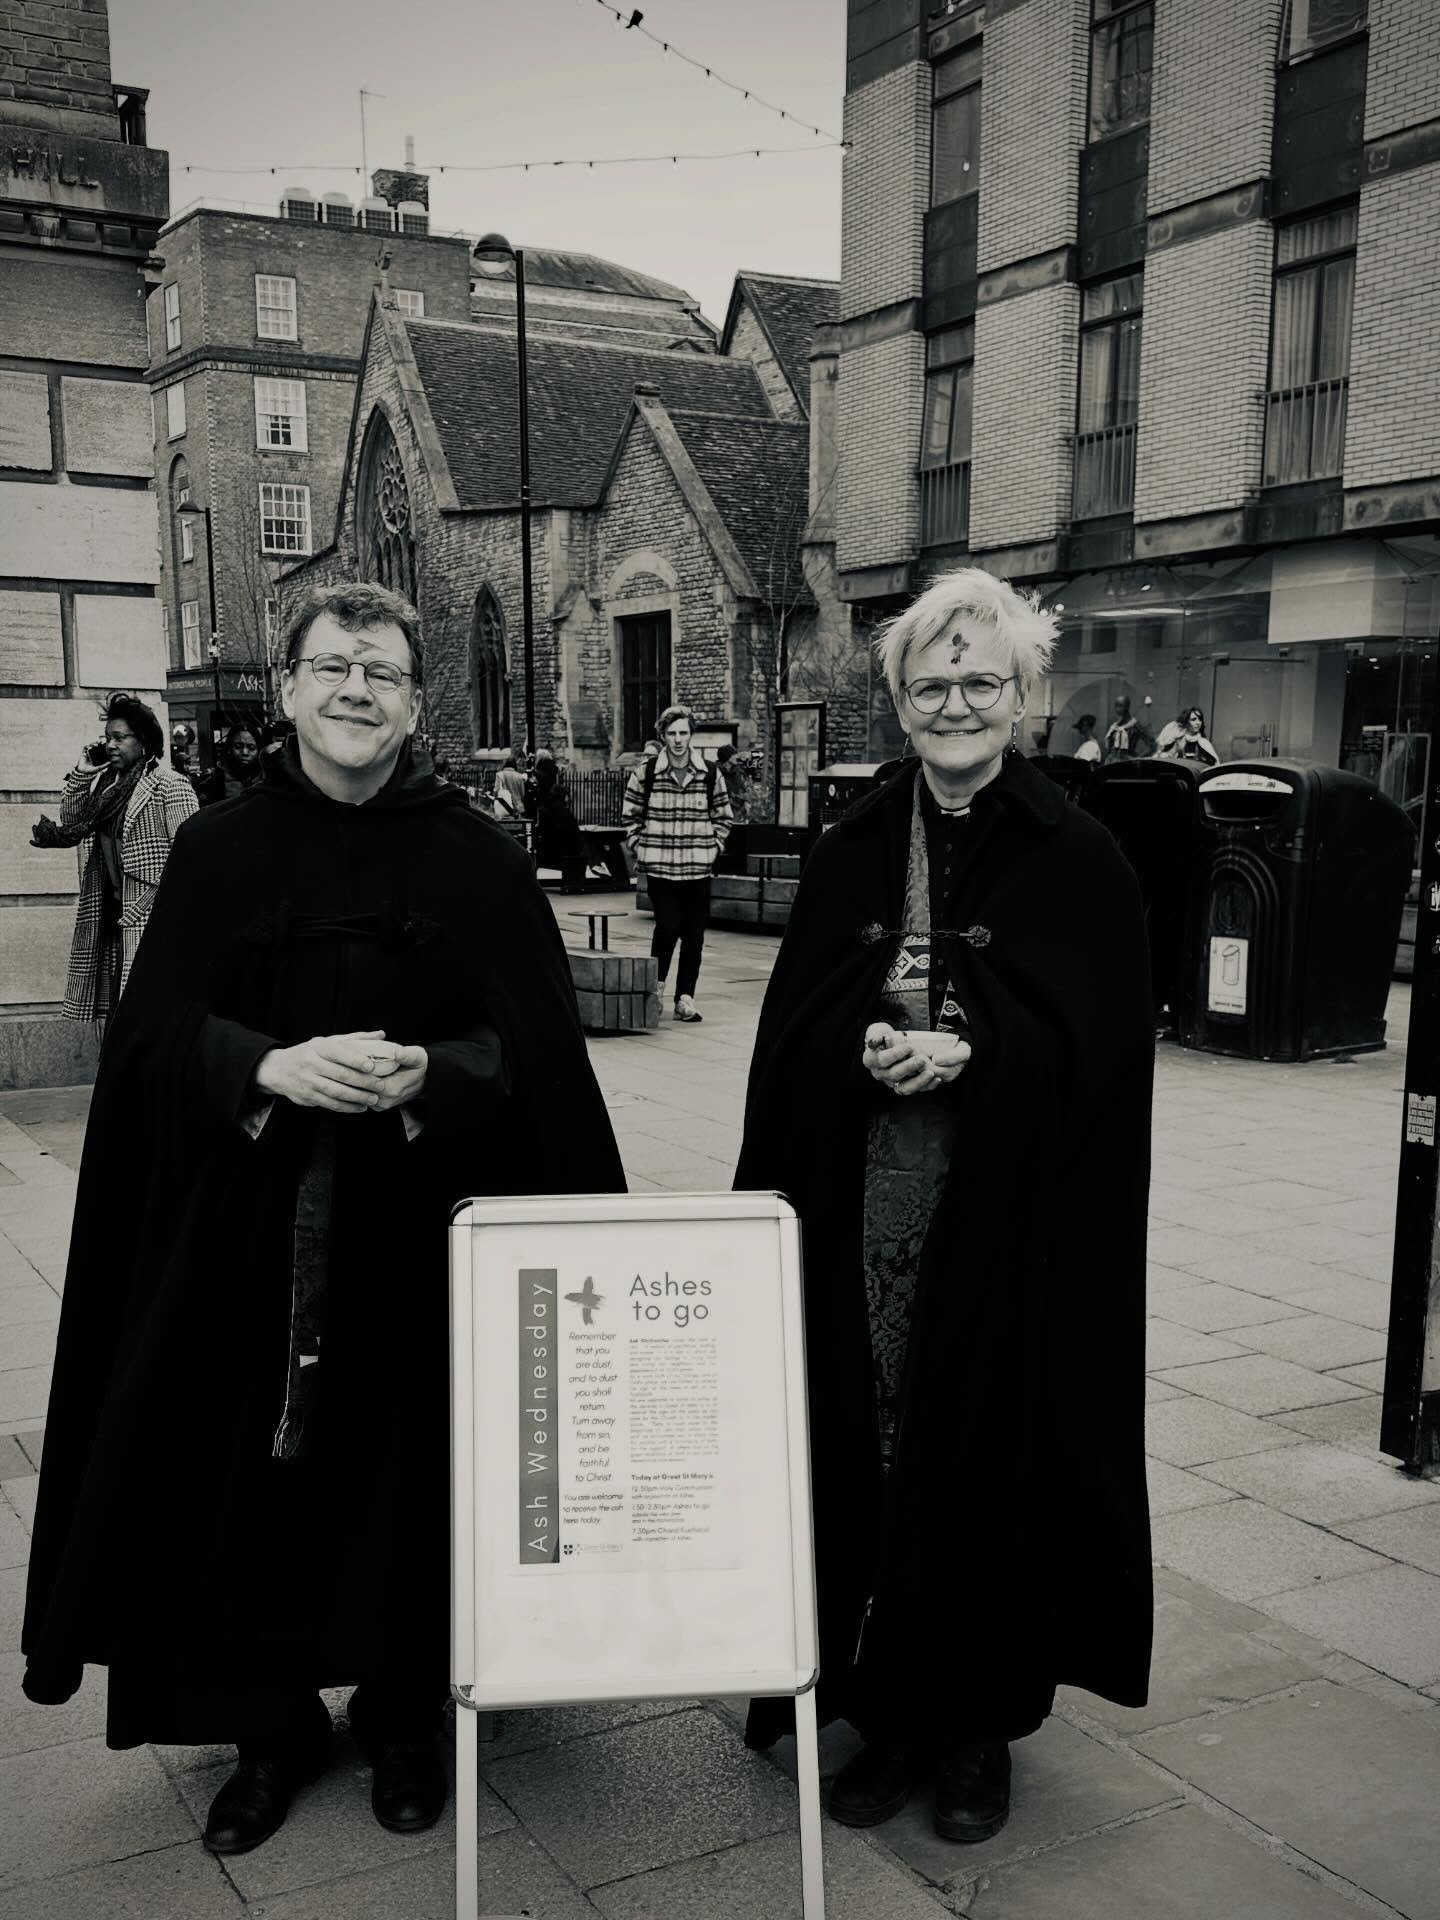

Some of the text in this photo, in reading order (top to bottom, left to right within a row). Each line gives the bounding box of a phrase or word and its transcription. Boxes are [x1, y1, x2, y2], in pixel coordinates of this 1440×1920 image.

[629, 1271, 712, 1297] Ashes
[632, 1300, 709, 1328] to go
[569, 1331, 617, 1341] Remember
[575, 1346, 611, 1357] that you
[569, 1373, 618, 1383] and to dust
[574, 1387, 612, 1400] you shall
[525, 1283, 553, 1552] Ash Wednesday
[572, 1416, 616, 1427] Turn away
[576, 1430, 596, 1439] from
[578, 1444, 610, 1453] and be
[579, 1457, 610, 1468] faithful
[575, 1474, 585, 1482] to
[631, 1473, 652, 1482] Today
